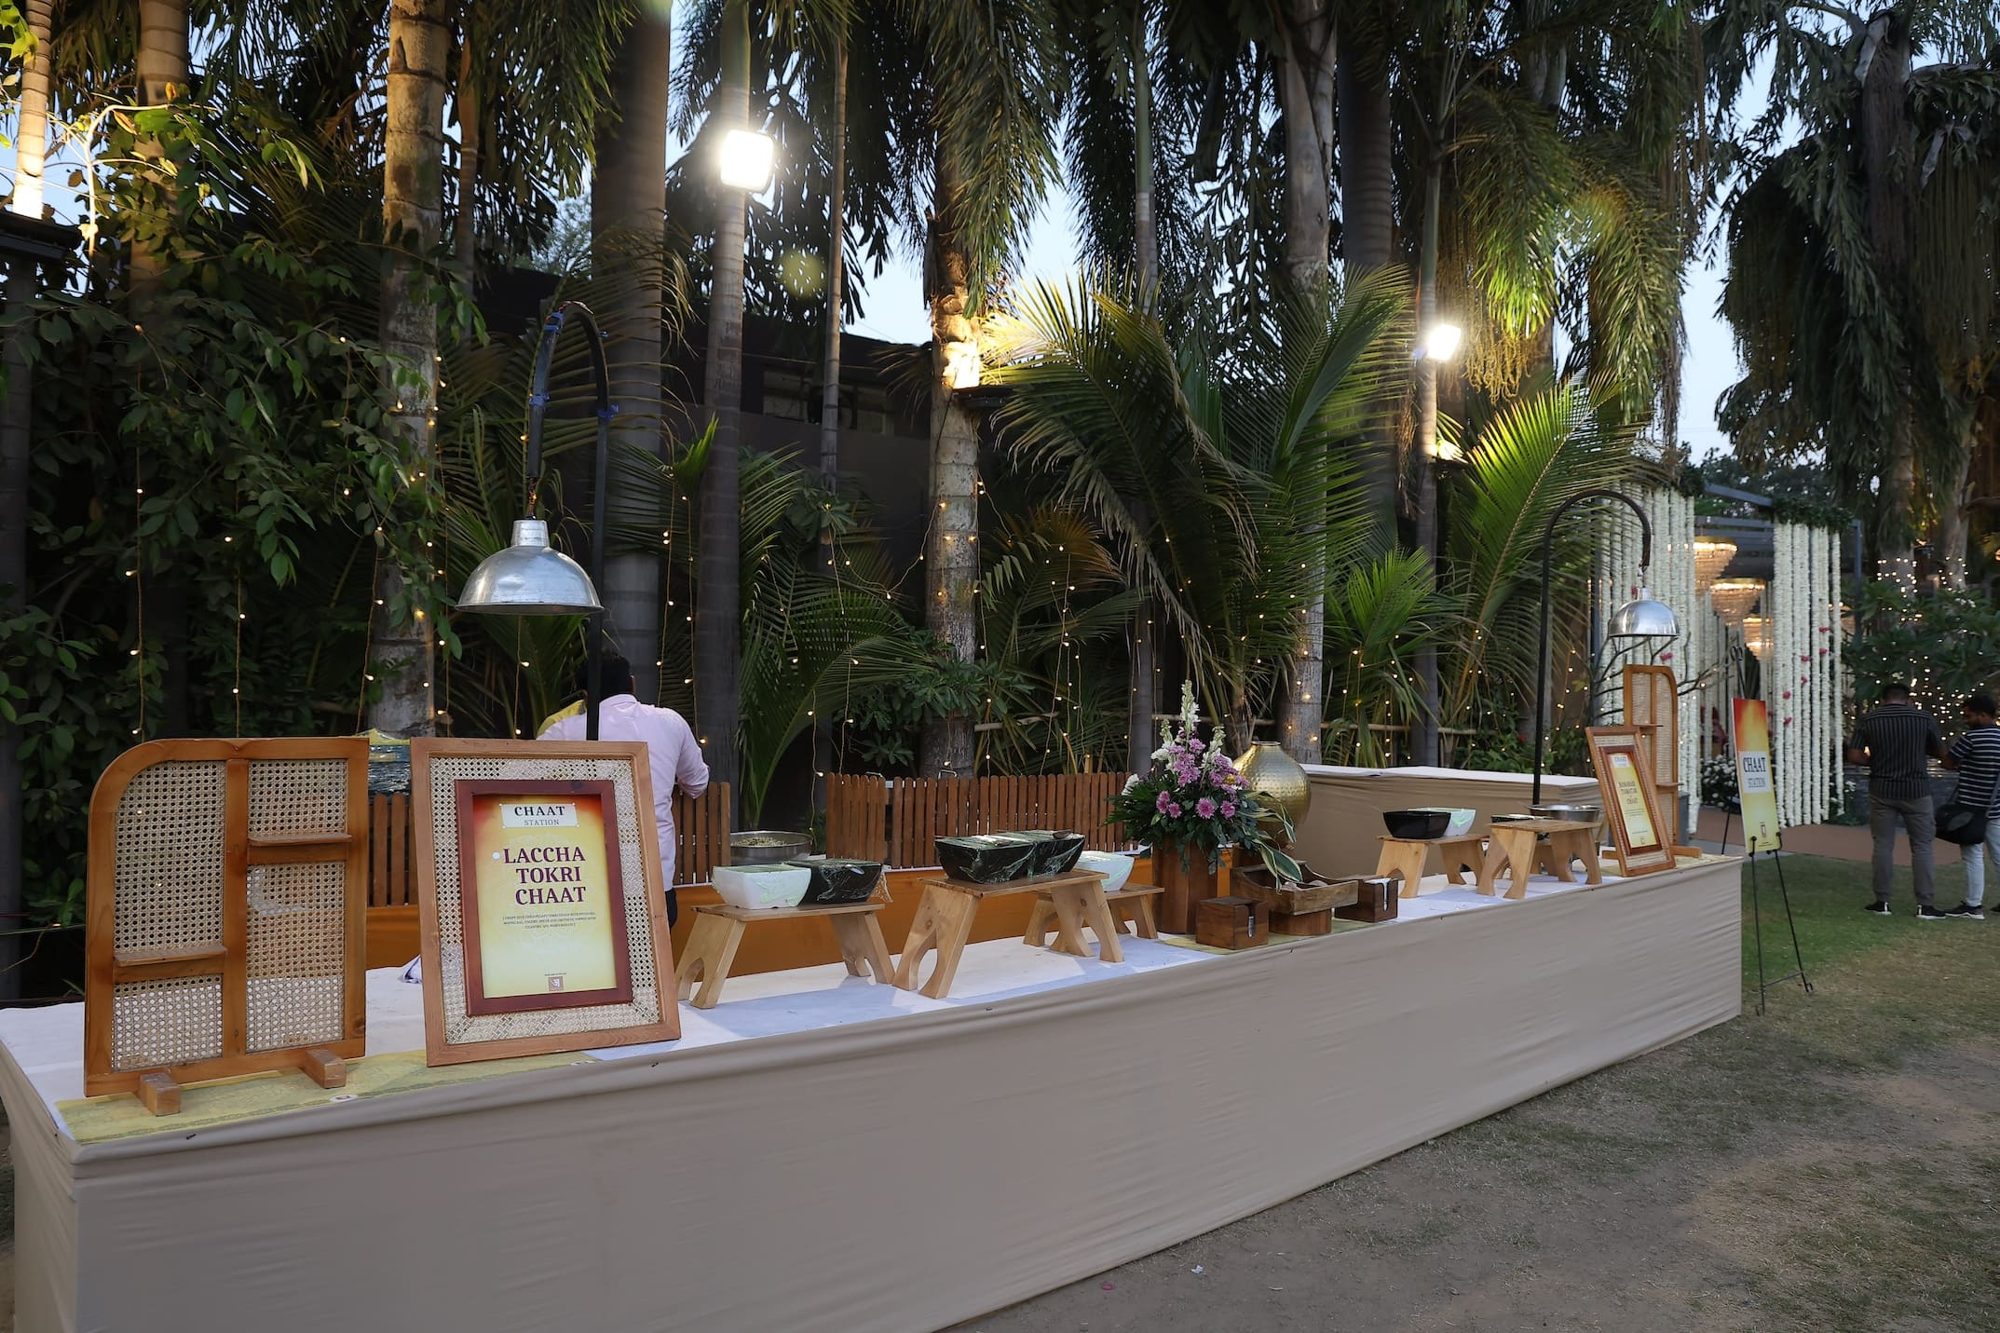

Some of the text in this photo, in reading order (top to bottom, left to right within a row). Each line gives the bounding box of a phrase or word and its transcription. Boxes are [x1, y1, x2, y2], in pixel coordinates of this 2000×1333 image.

[1743, 757, 1767, 773] CHAAT
[514, 806, 565, 817] CHAAT
[503, 846, 586, 864] LACCHA
[516, 866, 581, 884] TOKRI
[515, 886, 586, 905] CHAAT
